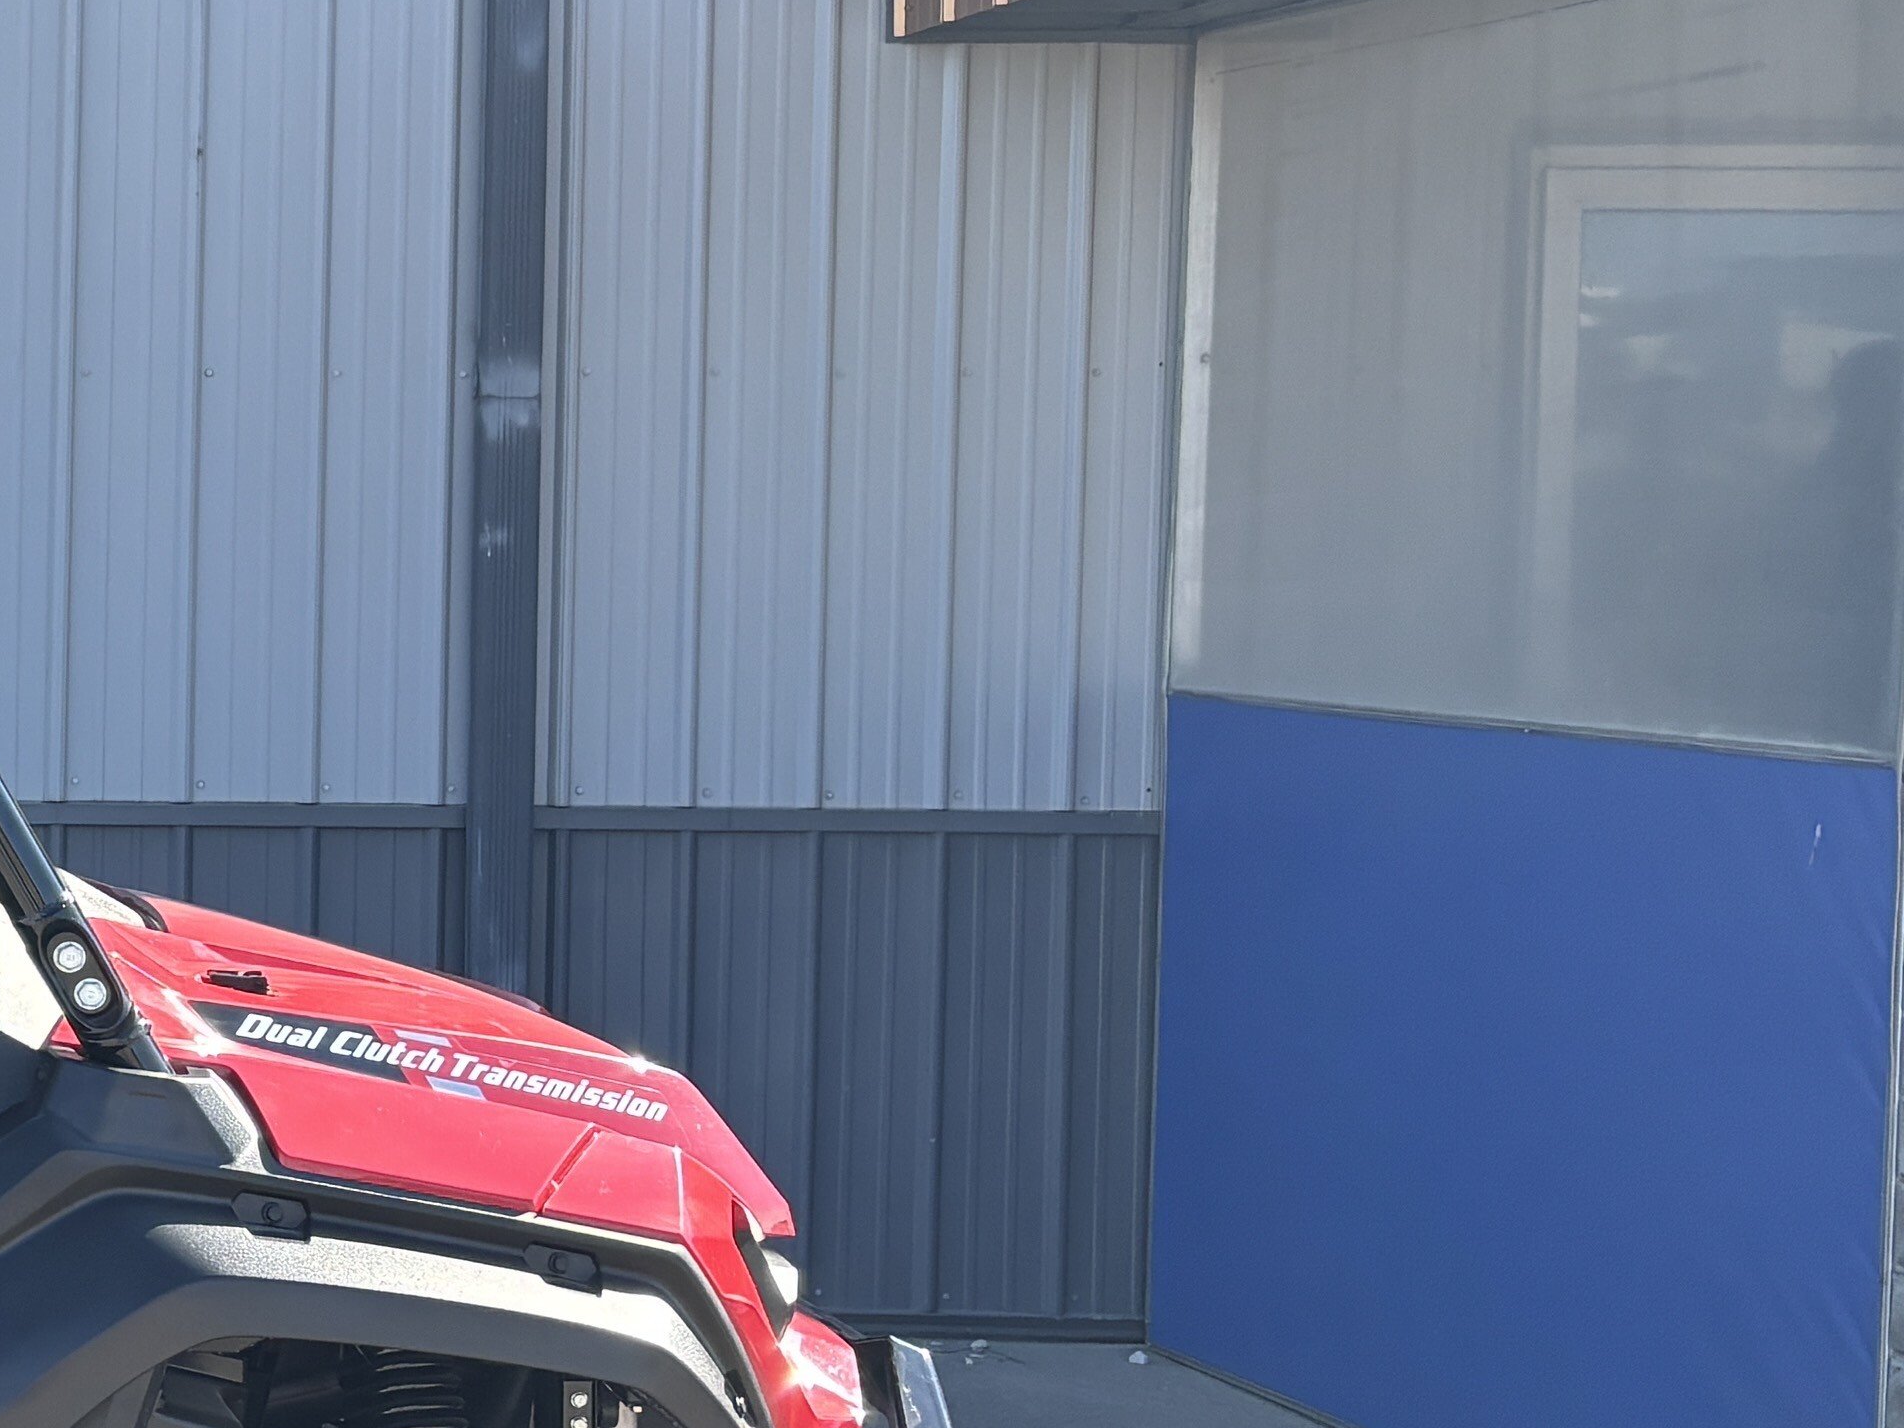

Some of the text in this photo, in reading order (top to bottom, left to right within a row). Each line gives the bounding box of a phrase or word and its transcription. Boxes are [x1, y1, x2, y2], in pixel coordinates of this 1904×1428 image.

[235, 1012, 669, 1122] Dual Clutch Transmission
